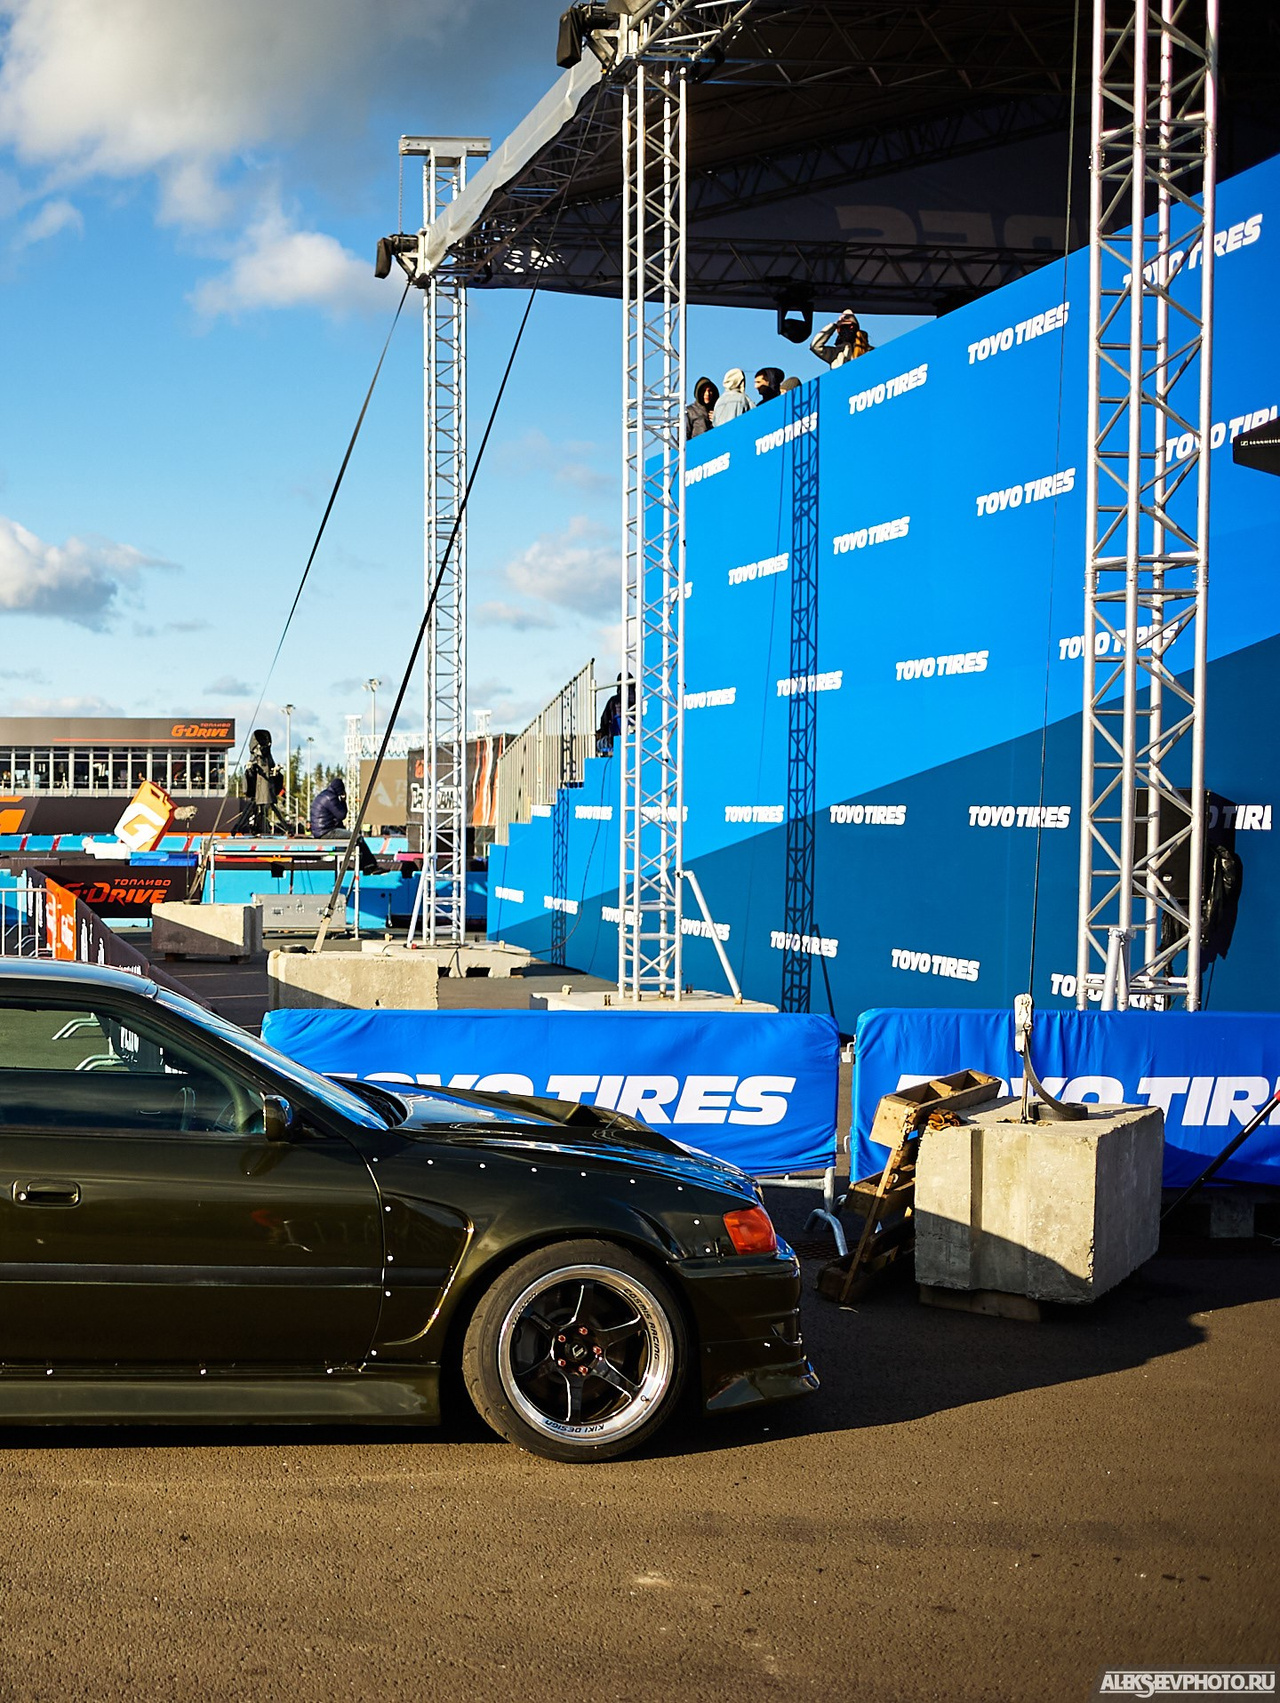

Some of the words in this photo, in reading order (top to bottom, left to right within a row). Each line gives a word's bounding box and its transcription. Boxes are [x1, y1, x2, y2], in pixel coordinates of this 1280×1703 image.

[1188, 213, 1263, 270] TRES
[968, 327, 1013, 364] TOYO
[1015, 301, 1070, 345] TIRES
[848, 384, 884, 415] TOYO
[885, 363, 928, 399] TIRES
[755, 428, 783, 455] TOYO
[784, 412, 818, 443] TIRES
[1166, 422, 1227, 462] TOO
[685, 466, 703, 488] OYO
[703, 452, 731, 479] TIRES
[976, 485, 1023, 516] TOYO
[1024, 468, 1076, 504] TIRES
[833, 529, 868, 555] TOYO
[868, 516, 911, 546] TIRES
[728, 562, 757, 585] TOYO
[757, 553, 789, 578] TIRES
[1059, 631, 1109, 661] TOO
[895, 657, 935, 681] TOYO
[935, 650, 989, 676] TIRES
[706, 687, 736, 707] TIRES
[777, 677, 806, 698] TOYO
[806, 670, 843, 692] TIRES
[725, 806, 752, 822] TOYO
[752, 805, 784, 823] TIRES
[829, 805, 864, 825] TOYO
[864, 805, 907, 826] TIRES
[968, 805, 1016, 828] TOYO
[1016, 806, 1071, 829] TIRES
[114, 878, 171, 887] ТОПЛИВО
[681, 918, 701, 938] OYO
[700, 921, 731, 941] TIES
[770, 930, 801, 952] TOYO
[801, 935, 839, 958] TIRES
[891, 948, 932, 973] TOYO
[931, 955, 980, 982] TIRES
[545, 1075, 797, 1126] TIRES
[1136, 1076, 1280, 1126] TIR
[624, 1288, 652, 1320] COSMIS
[648, 1321, 660, 1360] RACING
[545, 1419, 582, 1433] DESIGN
[584, 1424, 605, 1433] KIKI
